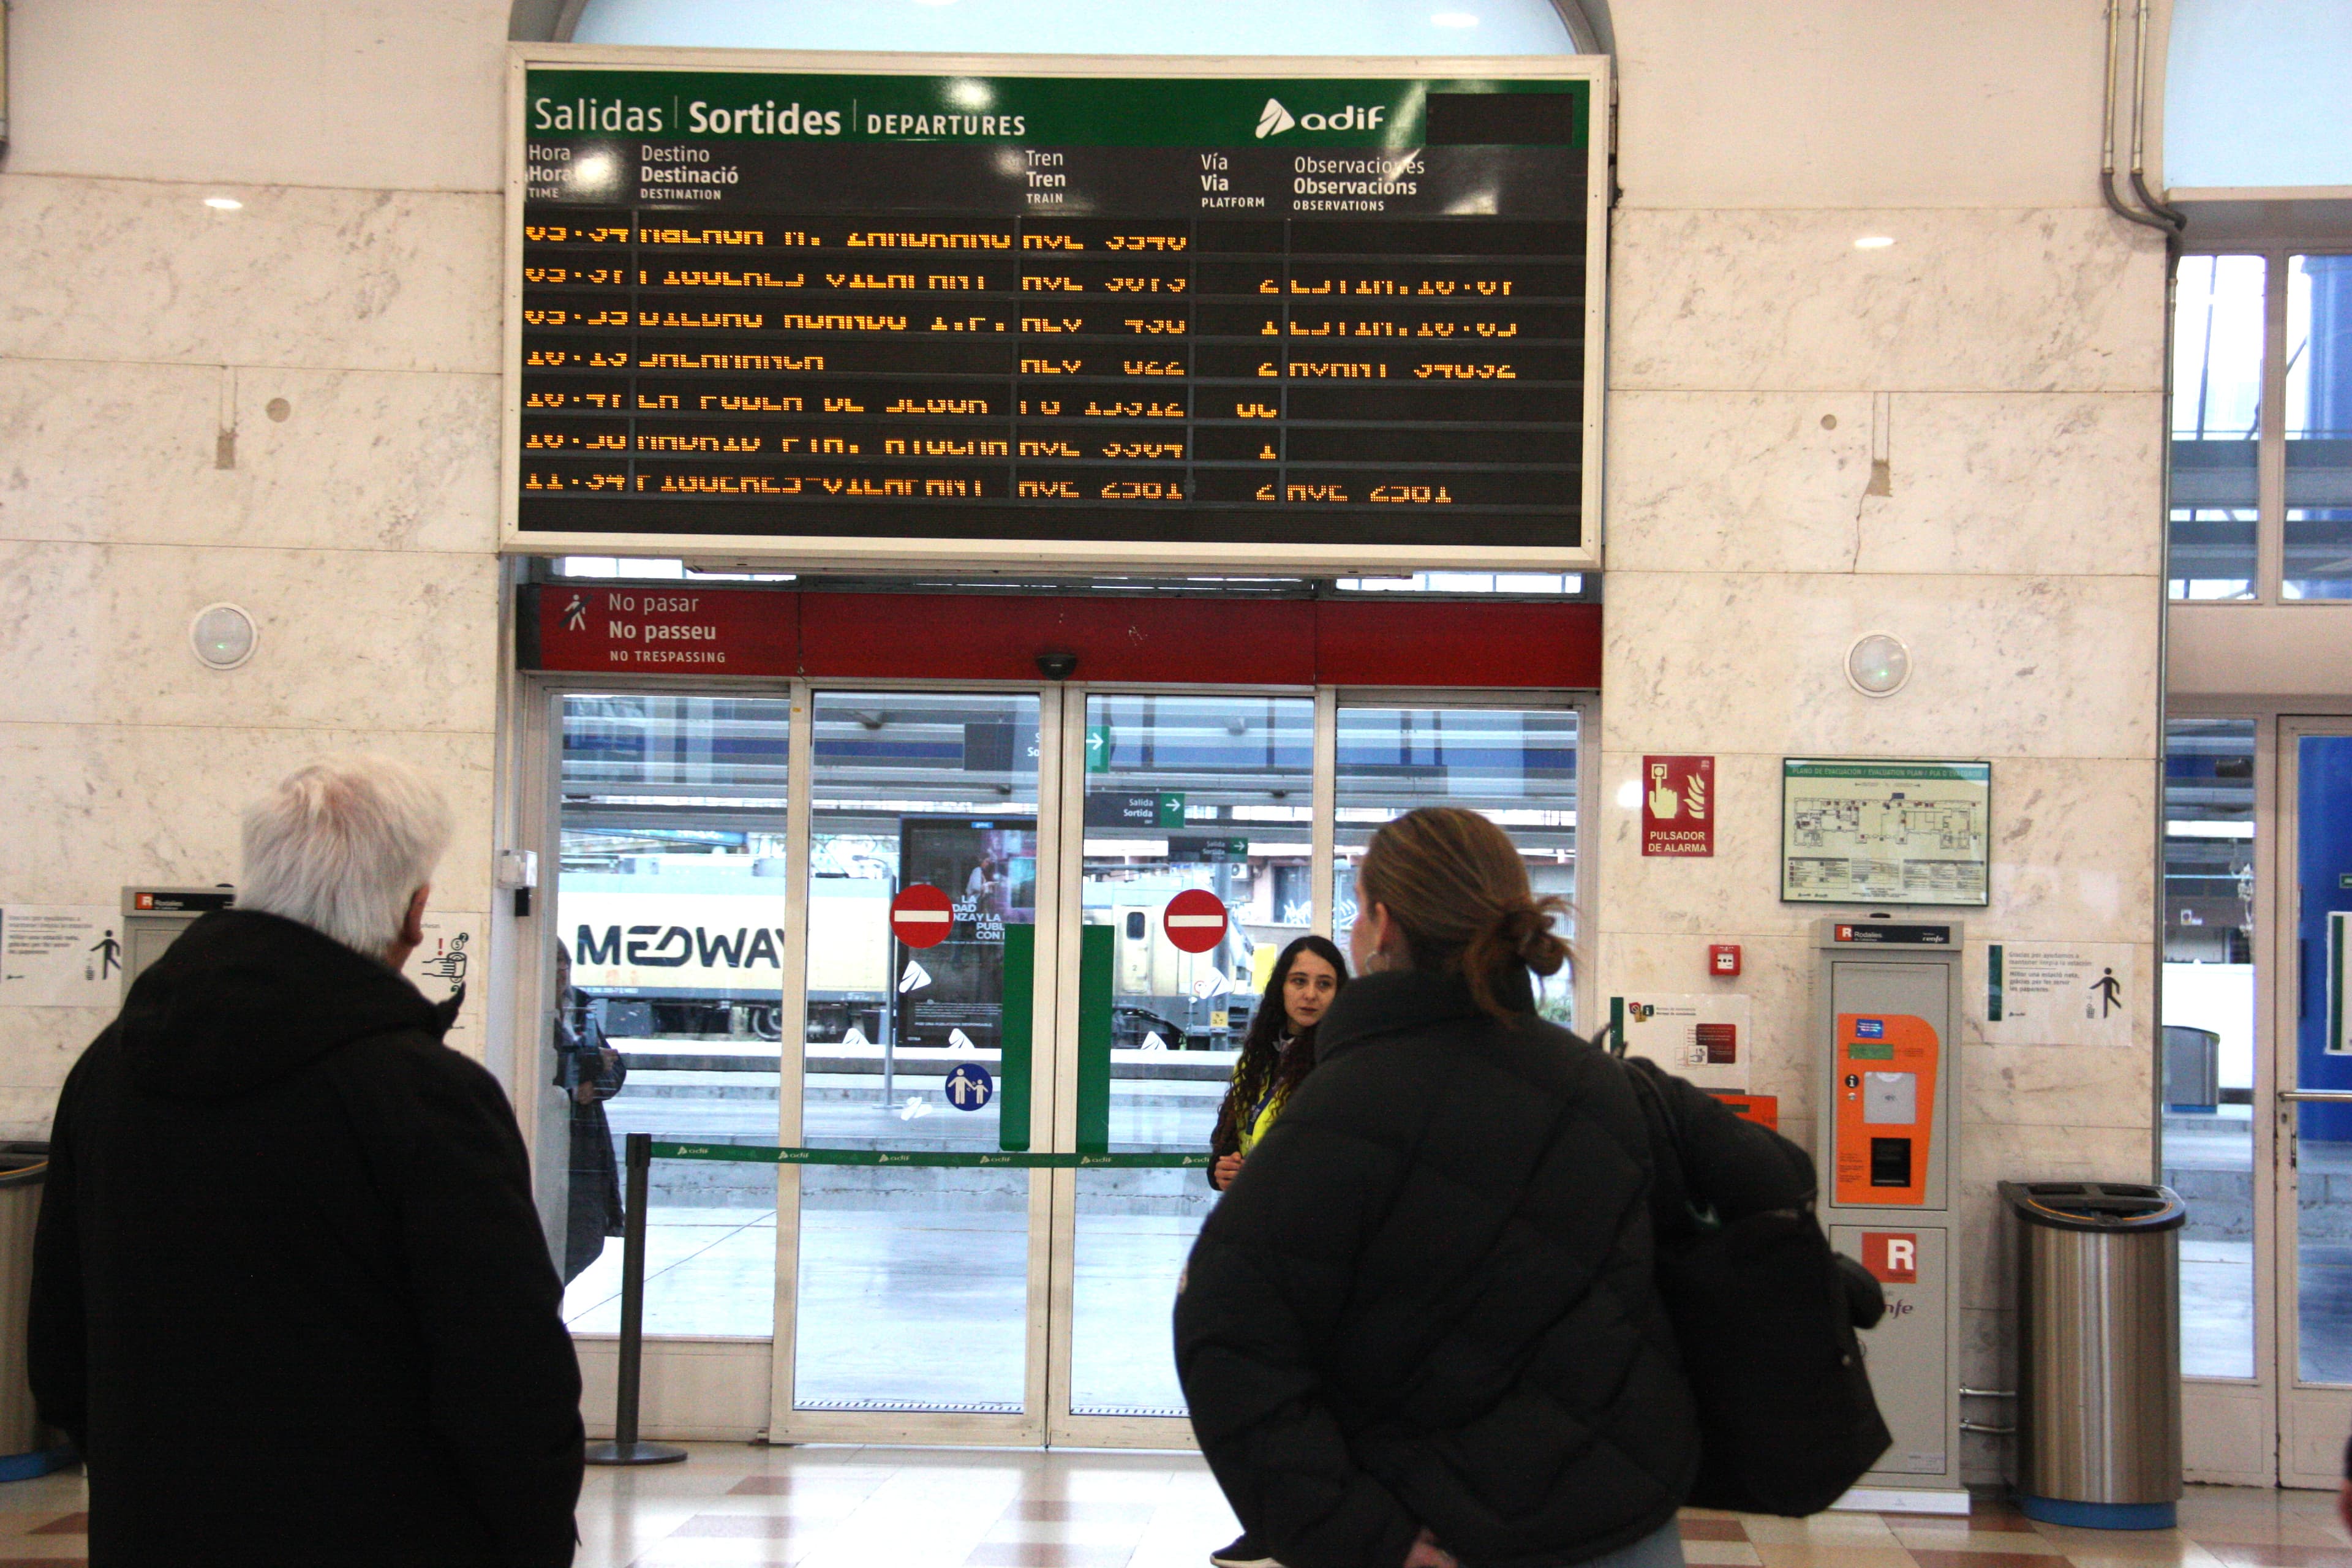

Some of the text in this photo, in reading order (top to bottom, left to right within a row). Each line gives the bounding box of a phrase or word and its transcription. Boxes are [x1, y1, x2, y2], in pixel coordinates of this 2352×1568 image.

[534, 98, 1026, 136] Salidas Sortides DEPARTURES
[1301, 105, 1385, 131] adif
[529, 145, 571, 162] Hora
[641, 145, 710, 162] Destino
[1025, 151, 1063, 167] Tren
[1201, 153, 1229, 170] Vía
[1294, 156, 1425, 175] Observaciones
[529, 166, 570, 183] Hora
[641, 166, 739, 184] Destinació
[1025, 172, 1066, 187] Tren
[1201, 175, 1229, 192] Via
[1294, 178, 1417, 196] Observacions
[529, 188, 559, 200] TIME
[640, 189, 722, 201] DESTINATION
[1026, 194, 1063, 204] TRAIN
[1201, 197, 1265, 208] PLATFORM
[1293, 200, 1385, 212] OBSERVATIONS
[609, 594, 699, 616] No pasar
[609, 622, 717, 644] No passeu
[609, 651, 726, 664] NO TRESPASSING
[1129, 799, 1154, 807] Salida
[1123, 809, 1154, 818] Sortida
[1649, 831, 1705, 840] PULSADOR
[1648, 843, 1707, 852] DE ALARMA
[986, 913, 1001, 922] LA
[976, 922, 1005, 931] PUBL
[1842, 927, 1852, 938] R
[976, 931, 1000, 940] CON
[576, 924, 784, 969] MEDWA
[1888, 1239, 1914, 1270] R
